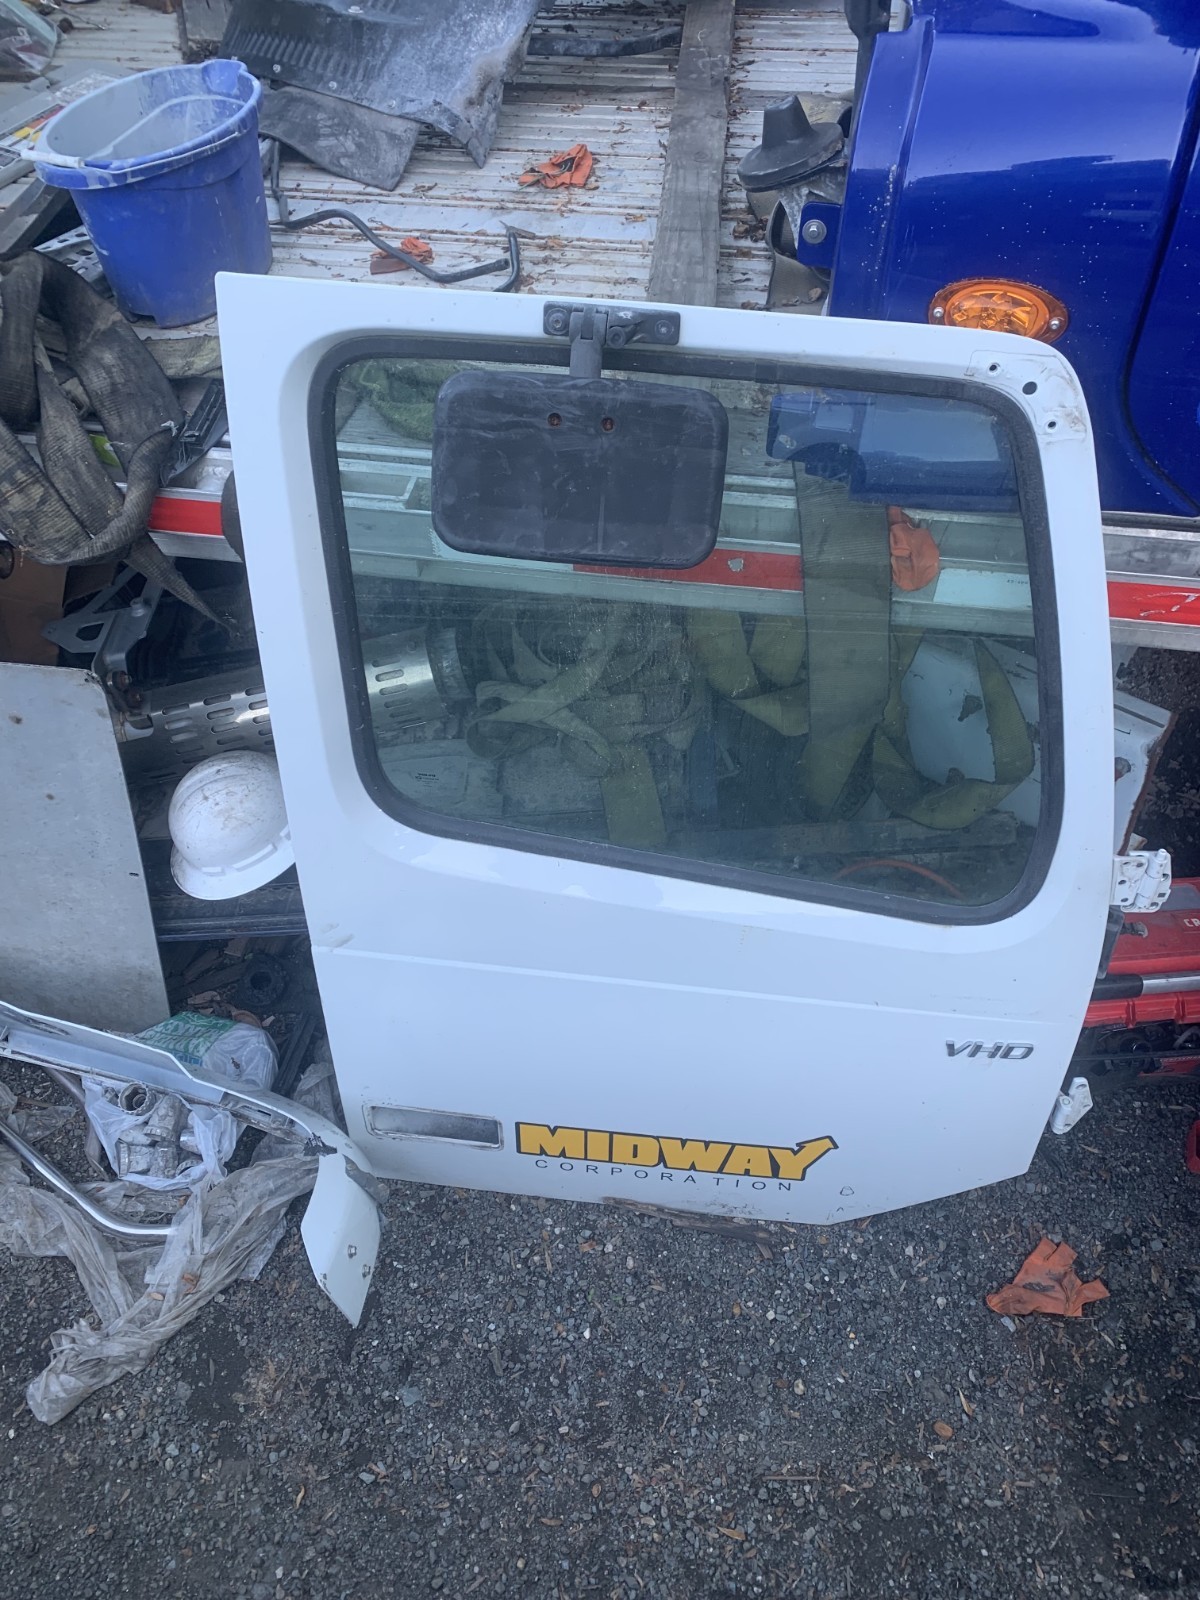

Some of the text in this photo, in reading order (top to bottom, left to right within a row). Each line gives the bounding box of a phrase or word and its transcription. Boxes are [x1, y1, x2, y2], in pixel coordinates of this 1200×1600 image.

[945, 1039, 1035, 1060] VHD
[515, 1121, 839, 1181] MIDWAY
[534, 1158, 792, 1191] CORPORATION
